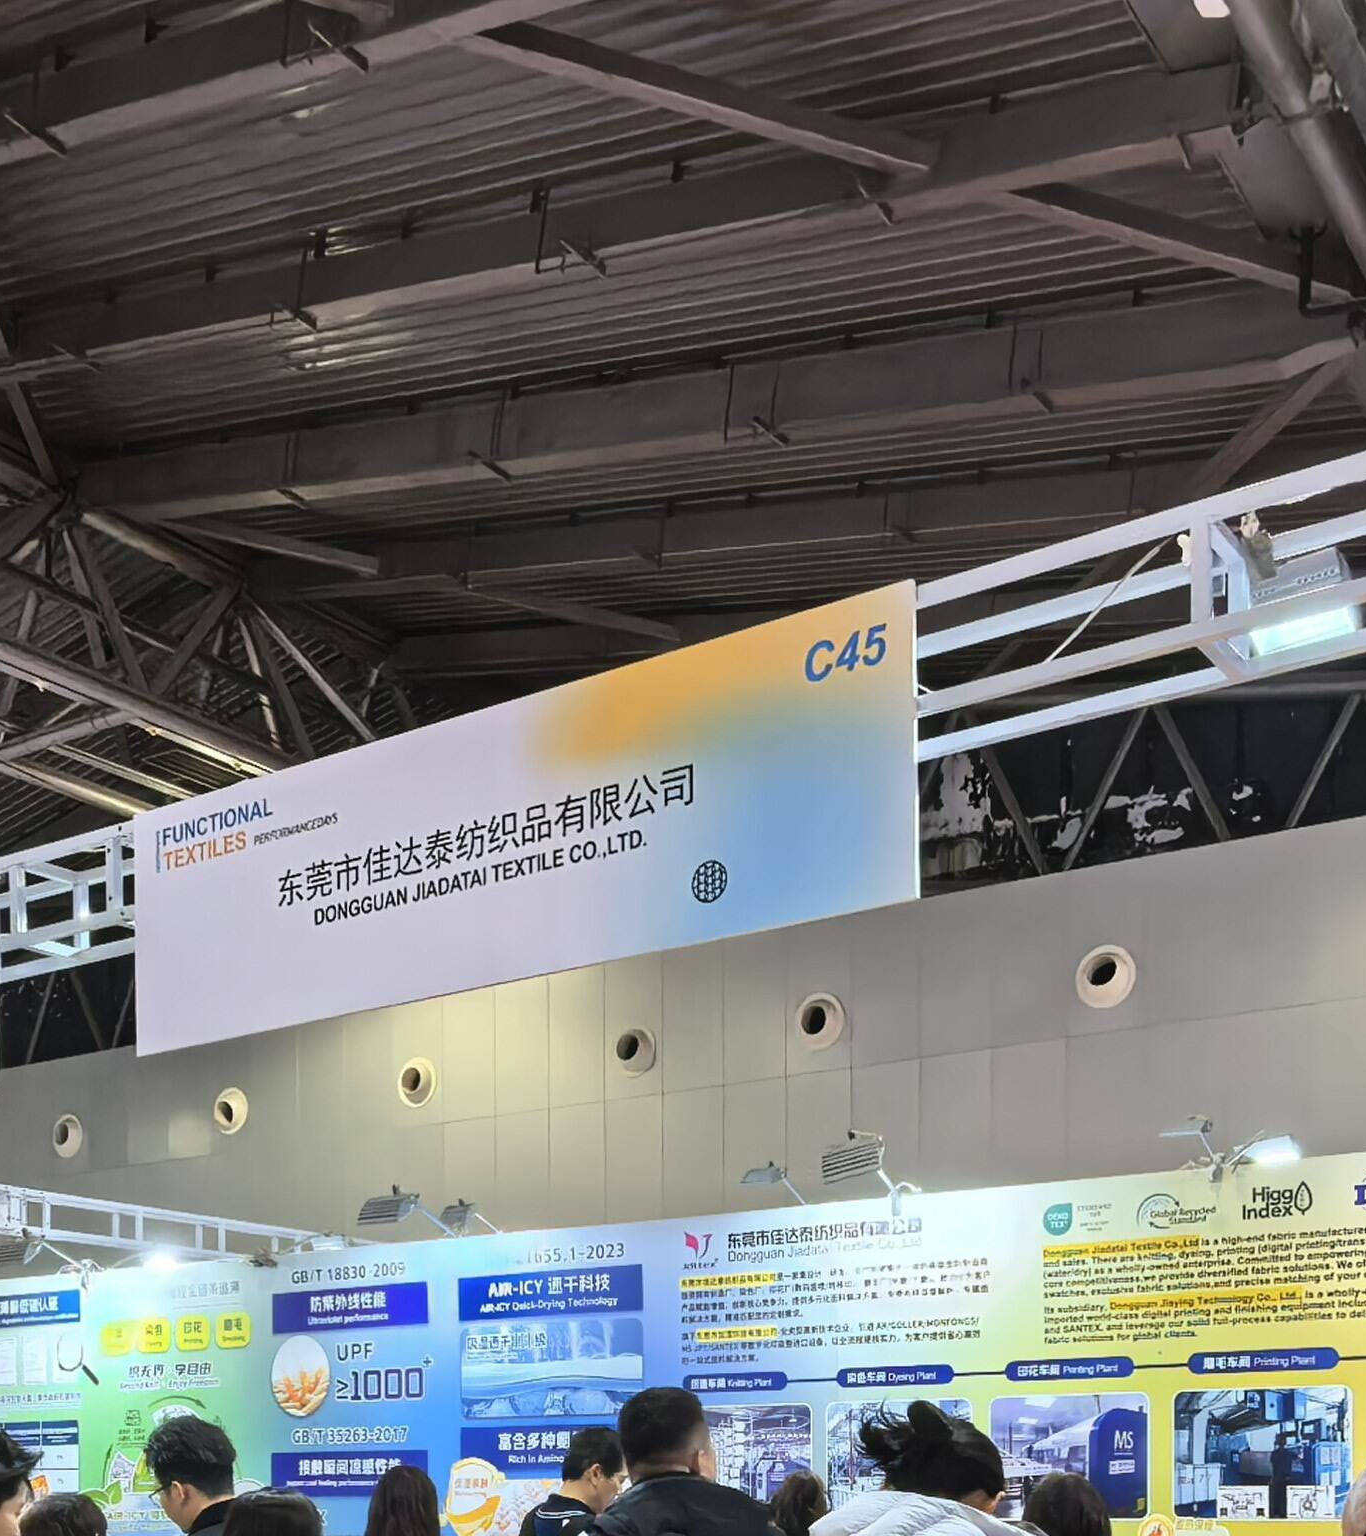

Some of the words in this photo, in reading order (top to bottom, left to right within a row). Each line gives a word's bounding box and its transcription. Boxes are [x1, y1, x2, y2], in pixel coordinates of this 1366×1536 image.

[804, 622, 888, 683] C45
[162, 798, 274, 847] FUNCTIONAL
[278, 763, 695, 907] 东莞市佳达泰纺织品有限公司
[163, 831, 247, 871] TEXTILES
[314, 889, 408, 926] DONGGUAN
[411, 870, 487, 903] JIADATAI
[491, 850, 565, 883] TEXTILE
[1252, 1186, 1293, 1206] Higg
[1149, 1208, 1175, 1218] Global
[1177, 1206, 1217, 1217] Recycled
[1242, 1203, 1293, 1220] Index
[1221, 1234, 1266, 1246] high-end
[1267, 1232, 1297, 1241] fabric
[728, 1248, 786, 1264] Dongguan
[1251, 1264, 1280, 1275] fabric
[1337, 1260, 1353, 1270] We
[292, 1268, 324, 1285] GB/T
[1136, 1284, 1164, 1294] fabric
[1235, 1278, 1271, 1289] precise
[1274, 1273, 1321, 1285] matching
[1337, 1271, 1361, 1283] your
[488, 1279, 544, 1299] AIR-ICY
[310, 1291, 387, 1313] 防紫外线性能
[512, 1298, 566, 1312] Quick-Drying
[567, 1296, 619, 1308] Technology
[1142, 1309, 1172, 1320] digital
[1214, 1305, 1233, 1315] and
[1235, 1303, 1278, 1315] finishing
[336, 1343, 374, 1362] UPF
[1096, 1362, 1119, 1374] Plant
[1253, 1355, 1289, 1369] Printing
[1291, 1354, 1316, 1366] Plant
[916, 1370, 937, 1381] Plant
[292, 1428, 325, 1444] GB/T
[328, 1427, 408, 1443] 35263-2017
[498, 1431, 577, 1451] 富含多种氨
[1114, 1429, 1134, 1450] MS
[508, 1454, 527, 1464] Rich
